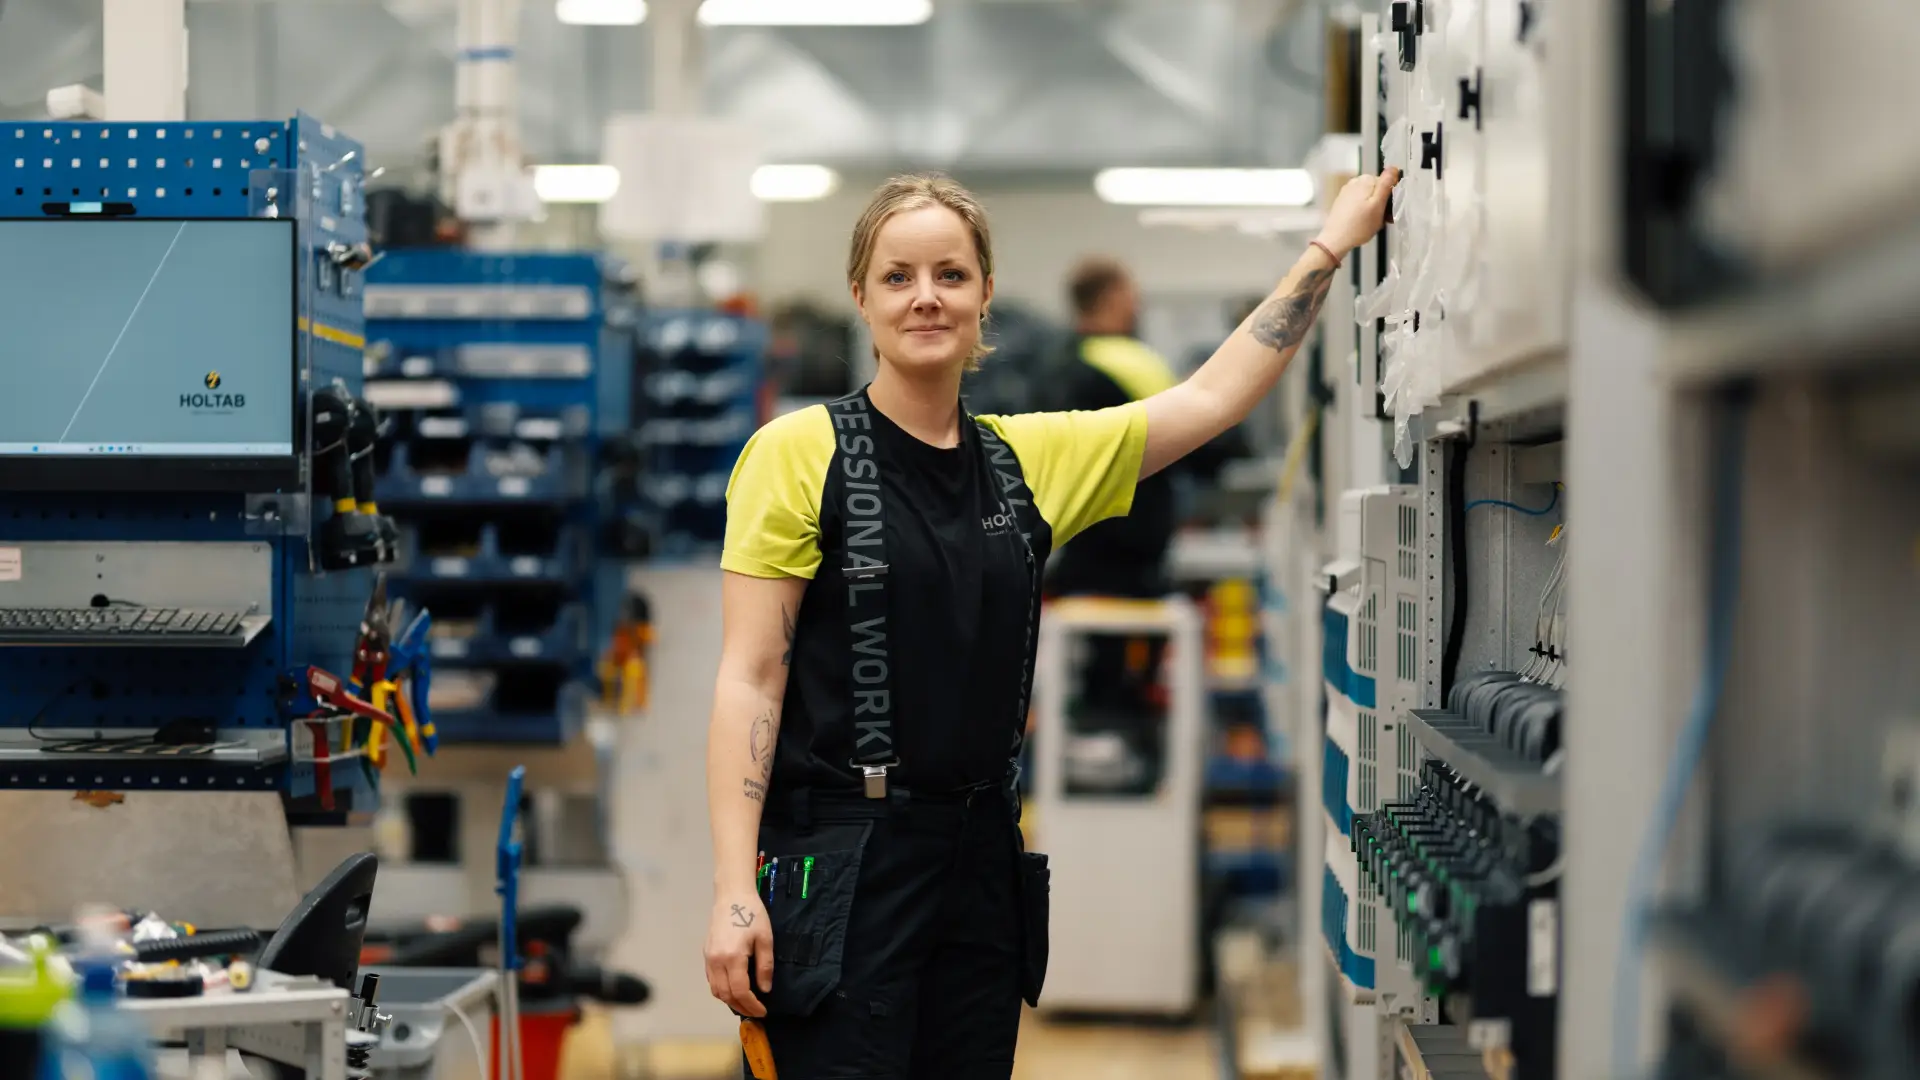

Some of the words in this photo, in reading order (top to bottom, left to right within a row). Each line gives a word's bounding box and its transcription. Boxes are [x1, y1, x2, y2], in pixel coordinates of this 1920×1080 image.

[180, 394, 245, 408] HOLTAB
[829, 391, 884, 607] FESSIONAL
[850, 616, 893, 762] WORK
